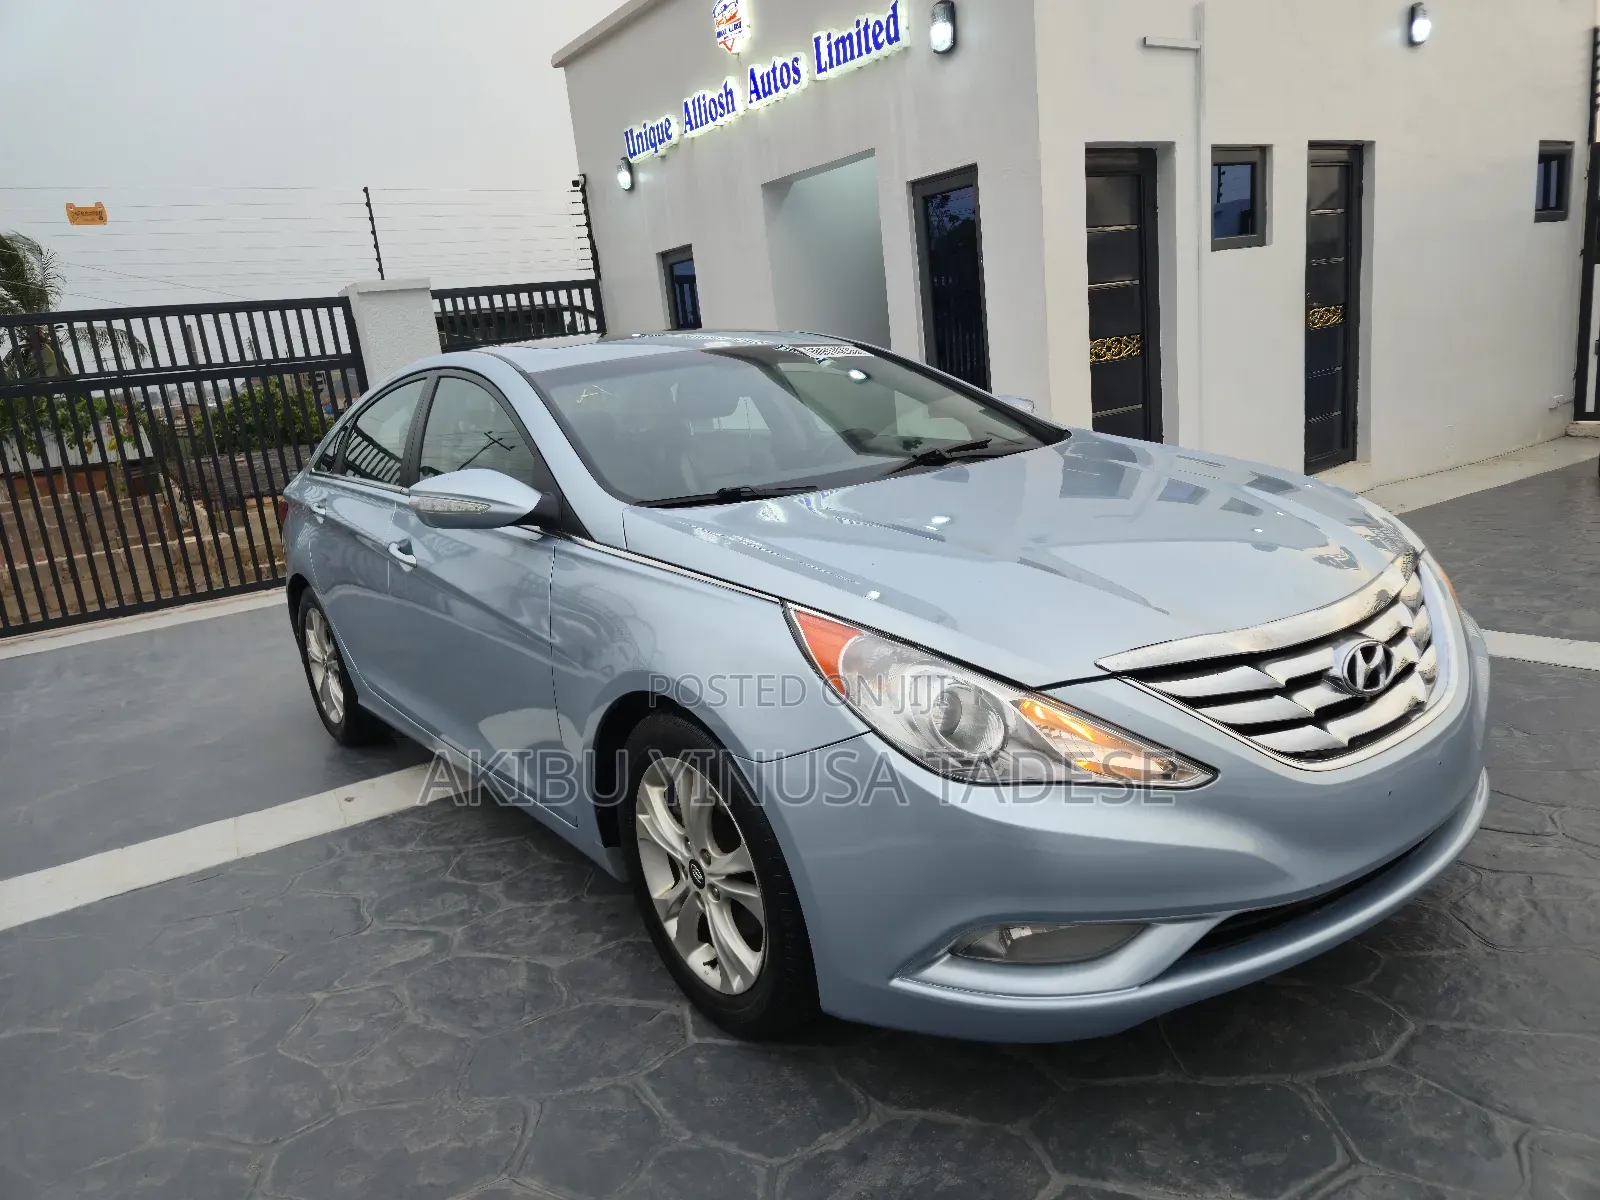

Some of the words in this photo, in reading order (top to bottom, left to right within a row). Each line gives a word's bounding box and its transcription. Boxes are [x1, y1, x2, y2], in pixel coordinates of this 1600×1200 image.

[624, 116, 673, 159] Unique
[683, 82, 736, 134] Alliosh
[749, 56, 801, 104] Autos
[813, 0, 901, 74] Limited
